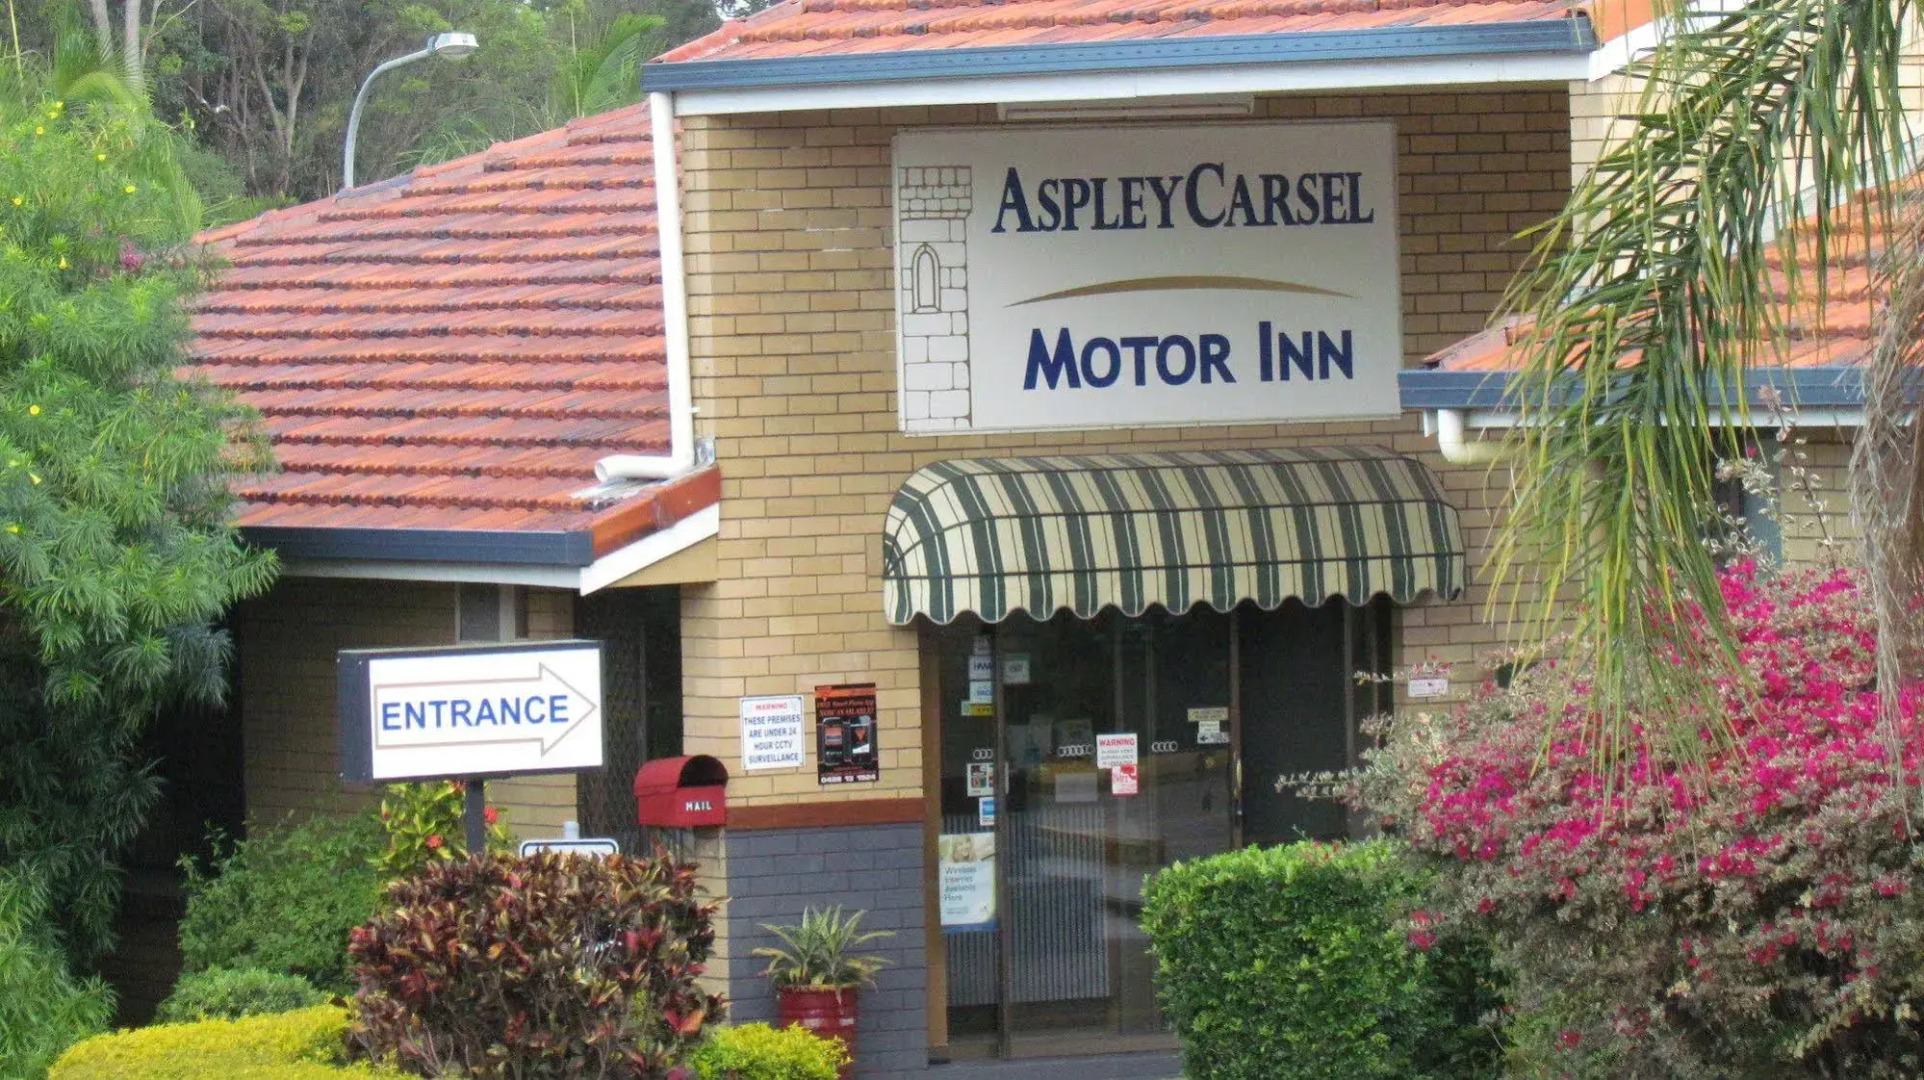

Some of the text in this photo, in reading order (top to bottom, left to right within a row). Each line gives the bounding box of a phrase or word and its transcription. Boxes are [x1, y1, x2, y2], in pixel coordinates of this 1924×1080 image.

[1023, 321, 1354, 390] MOTOR INN
[381, 695, 569, 731] ENTRANCE
[744, 714, 800, 725] THESE PREMISES
[749, 727, 797, 738] ARE UNDER 24
[754, 740, 793, 750] HOUR CCTV
[1100, 738, 1135, 747] WARNING
[749, 752, 799, 764] SURVEILLANCE
[685, 801, 712, 811] MAIL
